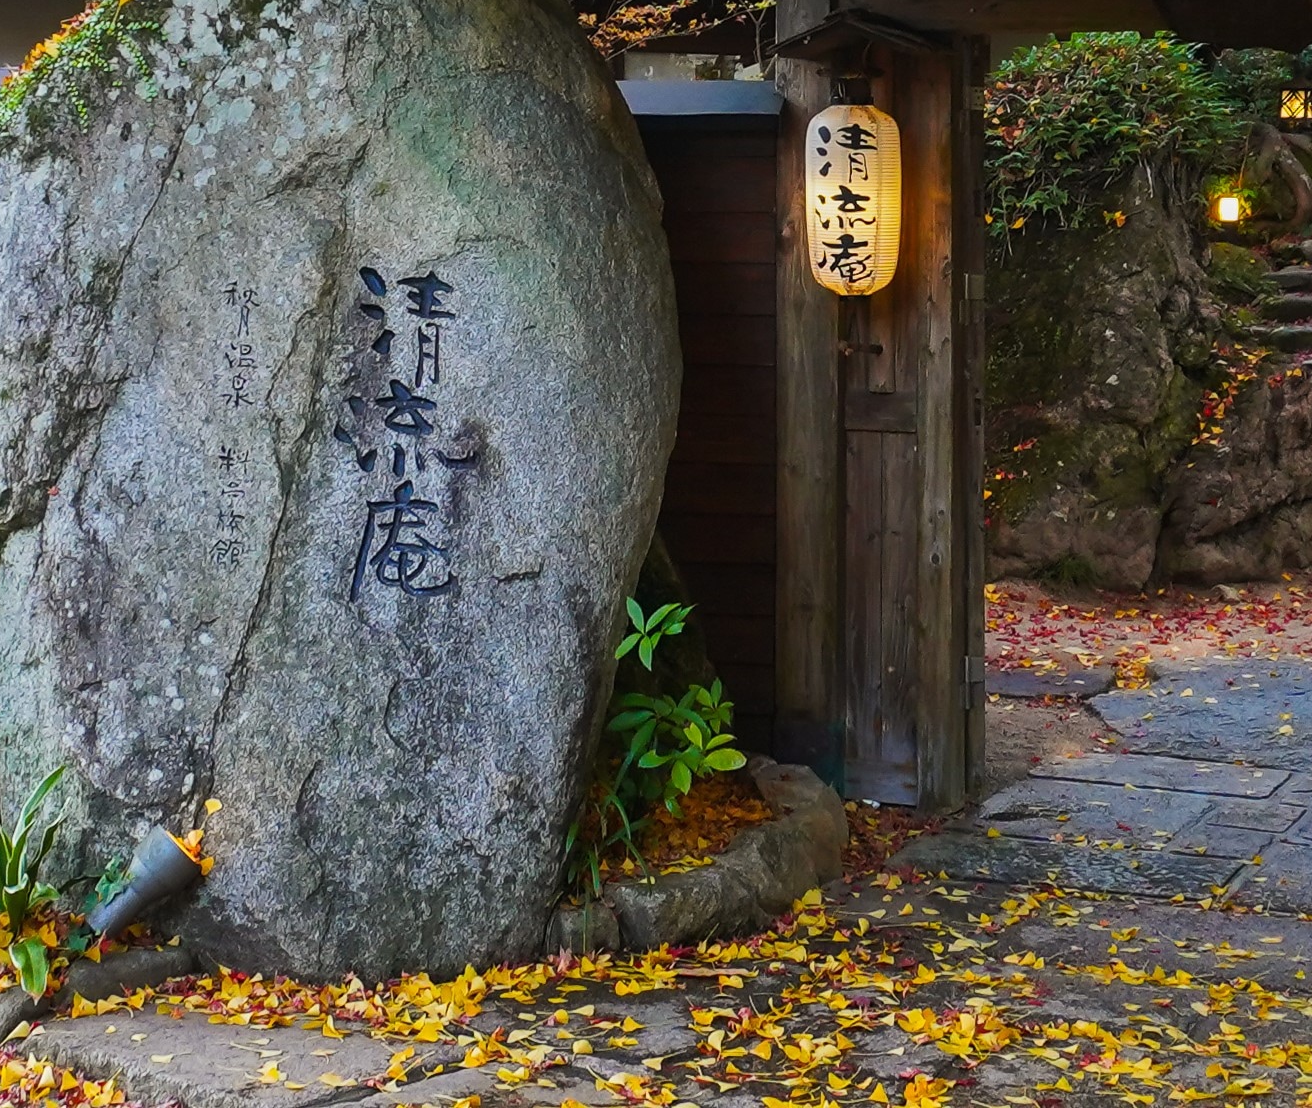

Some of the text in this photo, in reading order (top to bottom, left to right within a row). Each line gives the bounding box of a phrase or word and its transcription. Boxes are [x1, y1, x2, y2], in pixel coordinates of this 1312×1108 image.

[815, 123, 878, 284] 清流庵
[208, 281, 260, 567] 秋月温泉 料亭旅館
[334, 265, 480, 603] 清流庵
